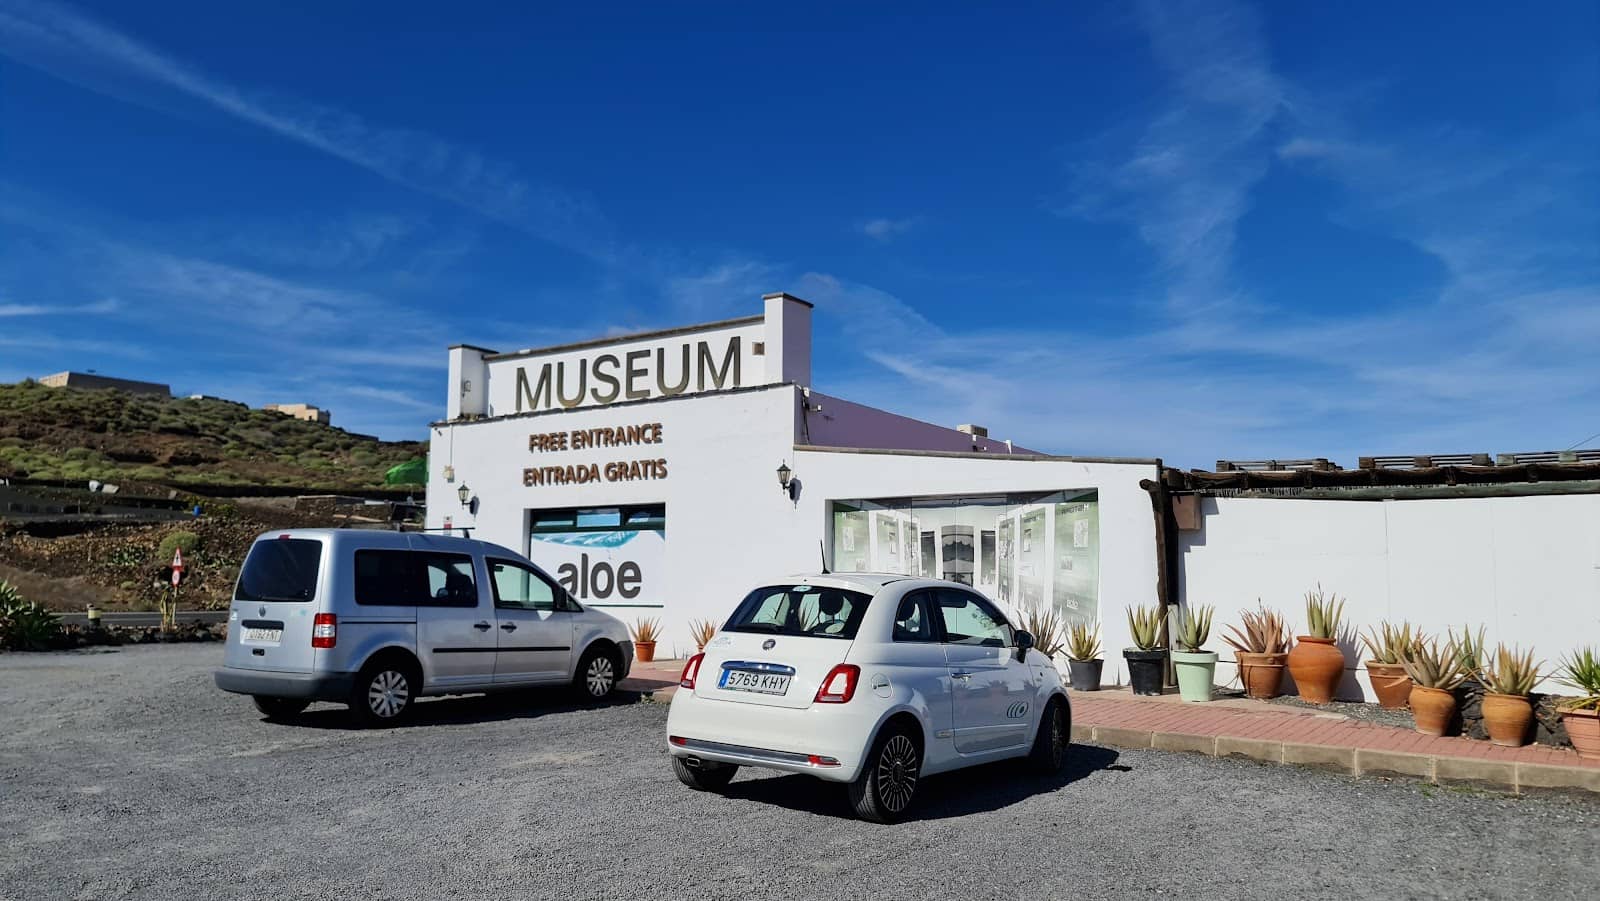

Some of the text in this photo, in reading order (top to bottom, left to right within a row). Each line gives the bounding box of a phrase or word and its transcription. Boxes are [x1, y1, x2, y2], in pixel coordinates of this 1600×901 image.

[515, 336, 741, 411] MUSEUM
[529, 423, 663, 453] FREE ENTRANCE
[523, 458, 668, 487] ENTRADA GRATIS
[557, 553, 642, 599] aloe
[728, 672, 787, 690] 5769 KHY
